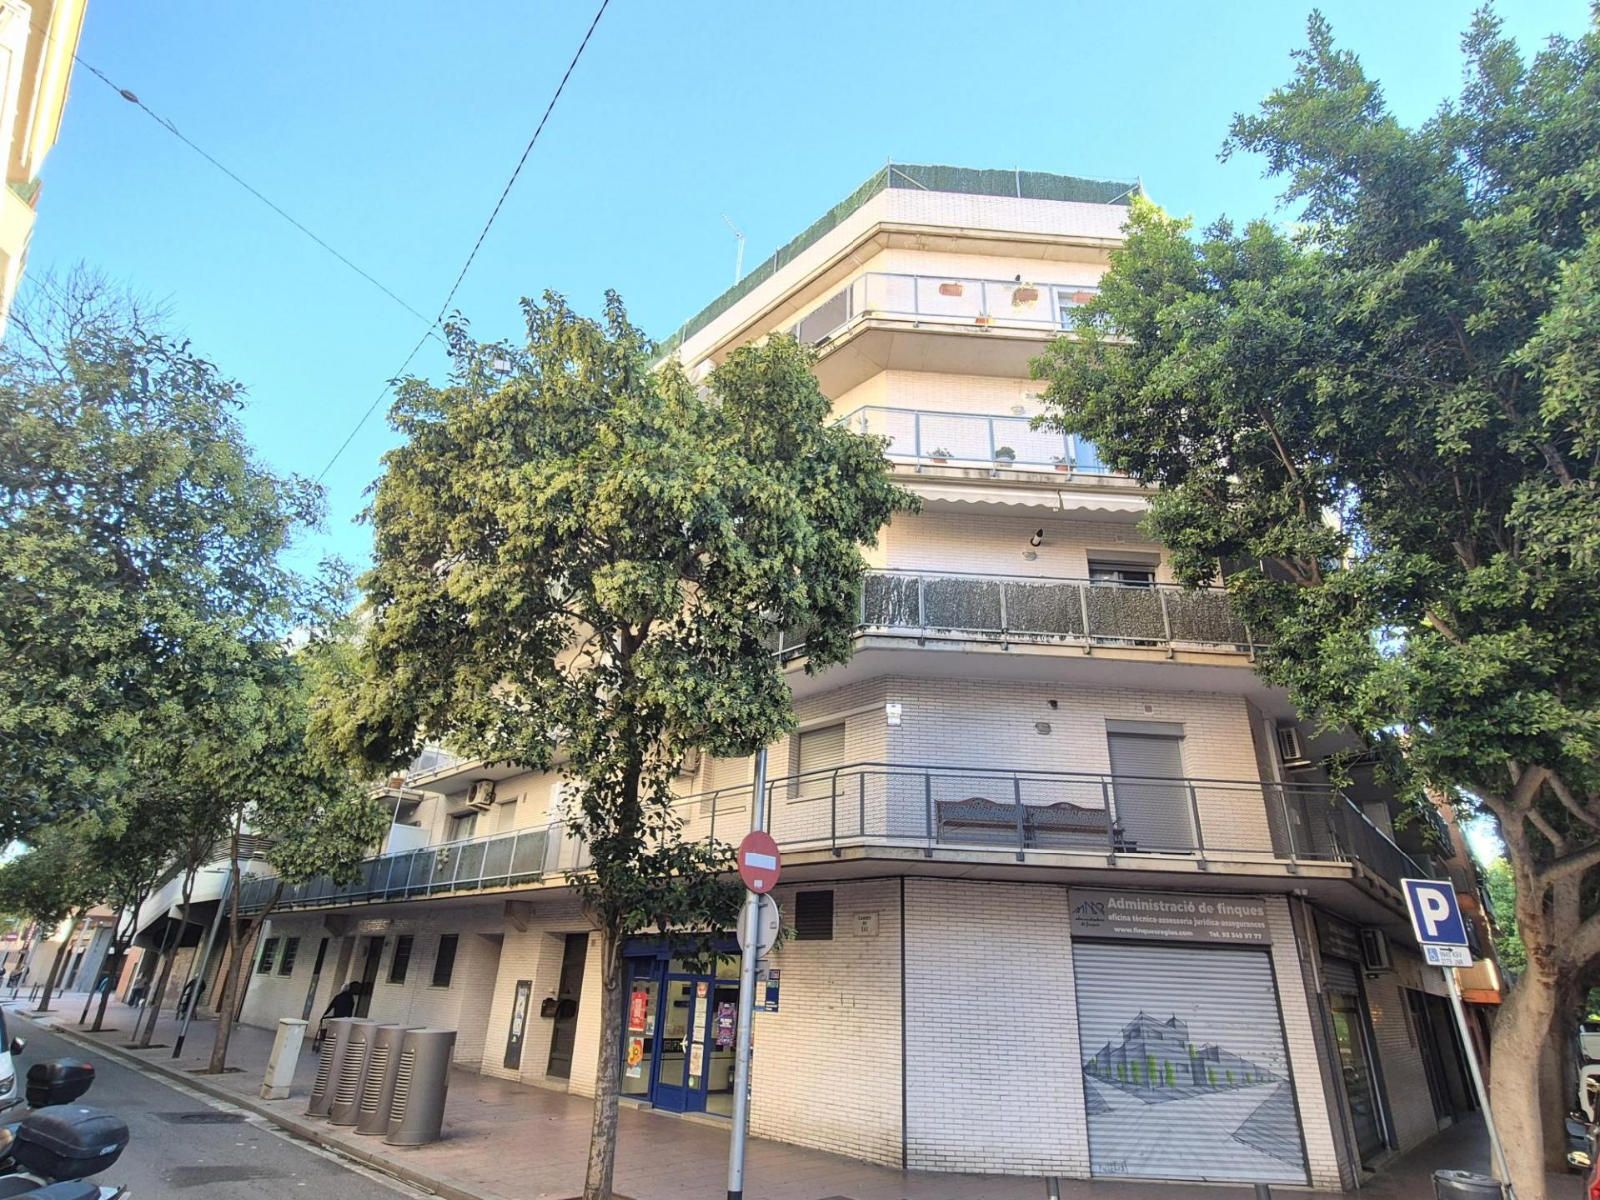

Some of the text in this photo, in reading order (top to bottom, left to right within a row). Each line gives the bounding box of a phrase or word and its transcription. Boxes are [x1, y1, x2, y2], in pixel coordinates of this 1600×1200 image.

[1107, 897, 1196, 914] Administració
[1198, 902, 1215, 914] de
[1217, 902, 1265, 918] finques
[1415, 888, 1450, 937] P
